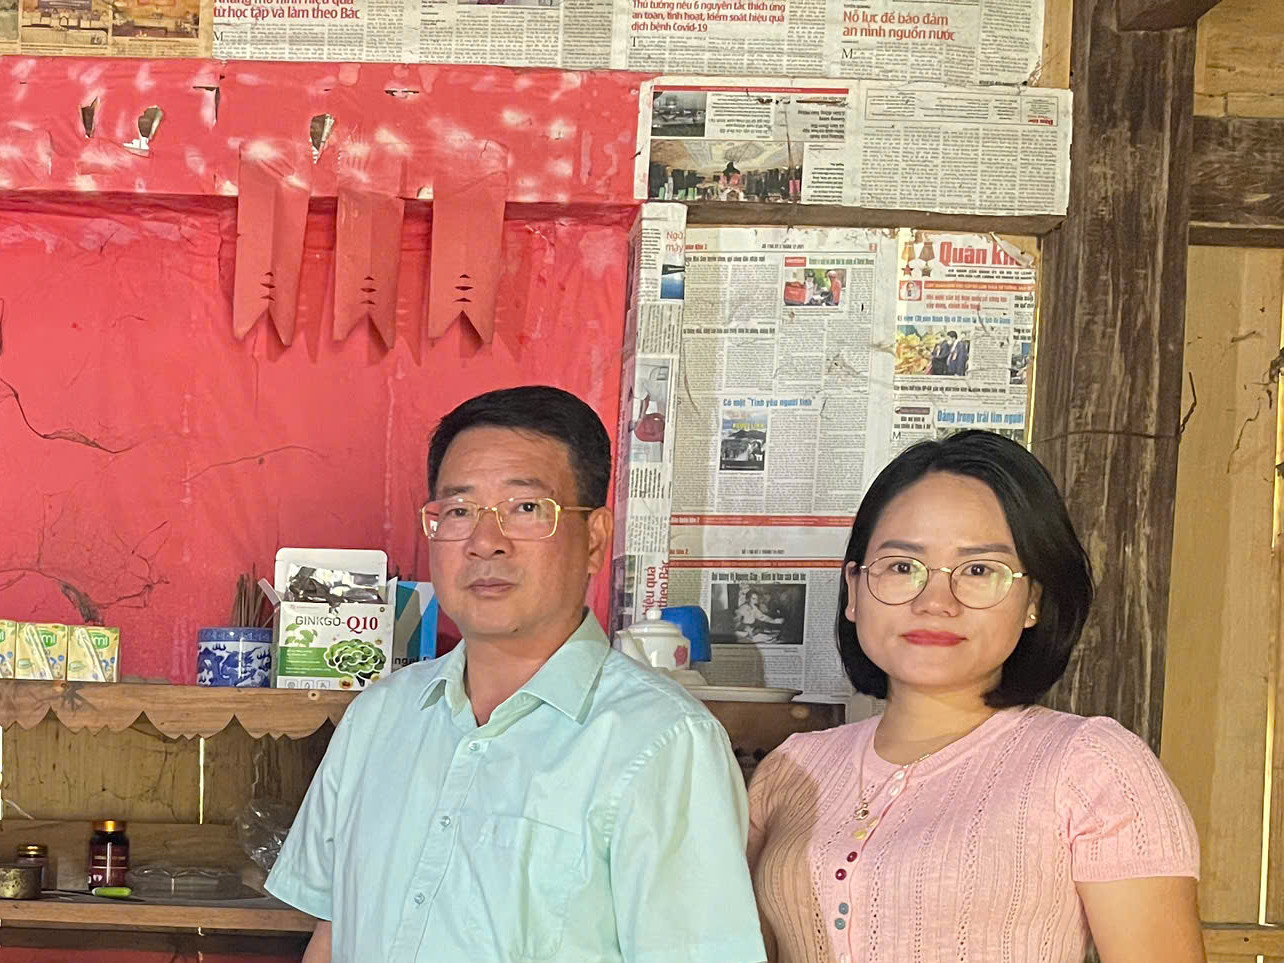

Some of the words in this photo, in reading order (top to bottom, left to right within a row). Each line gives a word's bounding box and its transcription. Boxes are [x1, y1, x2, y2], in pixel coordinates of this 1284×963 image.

[214, 7, 227, 17] từ
[228, 6, 247, 19] học
[251, 6, 269, 20] tập
[272, 6, 284, 17] và
[288, 6, 308, 18] làm
[312, 6, 337, 18] theo
[340, 7, 360, 18] Bác
[642, 591, 655, 615] iệu
